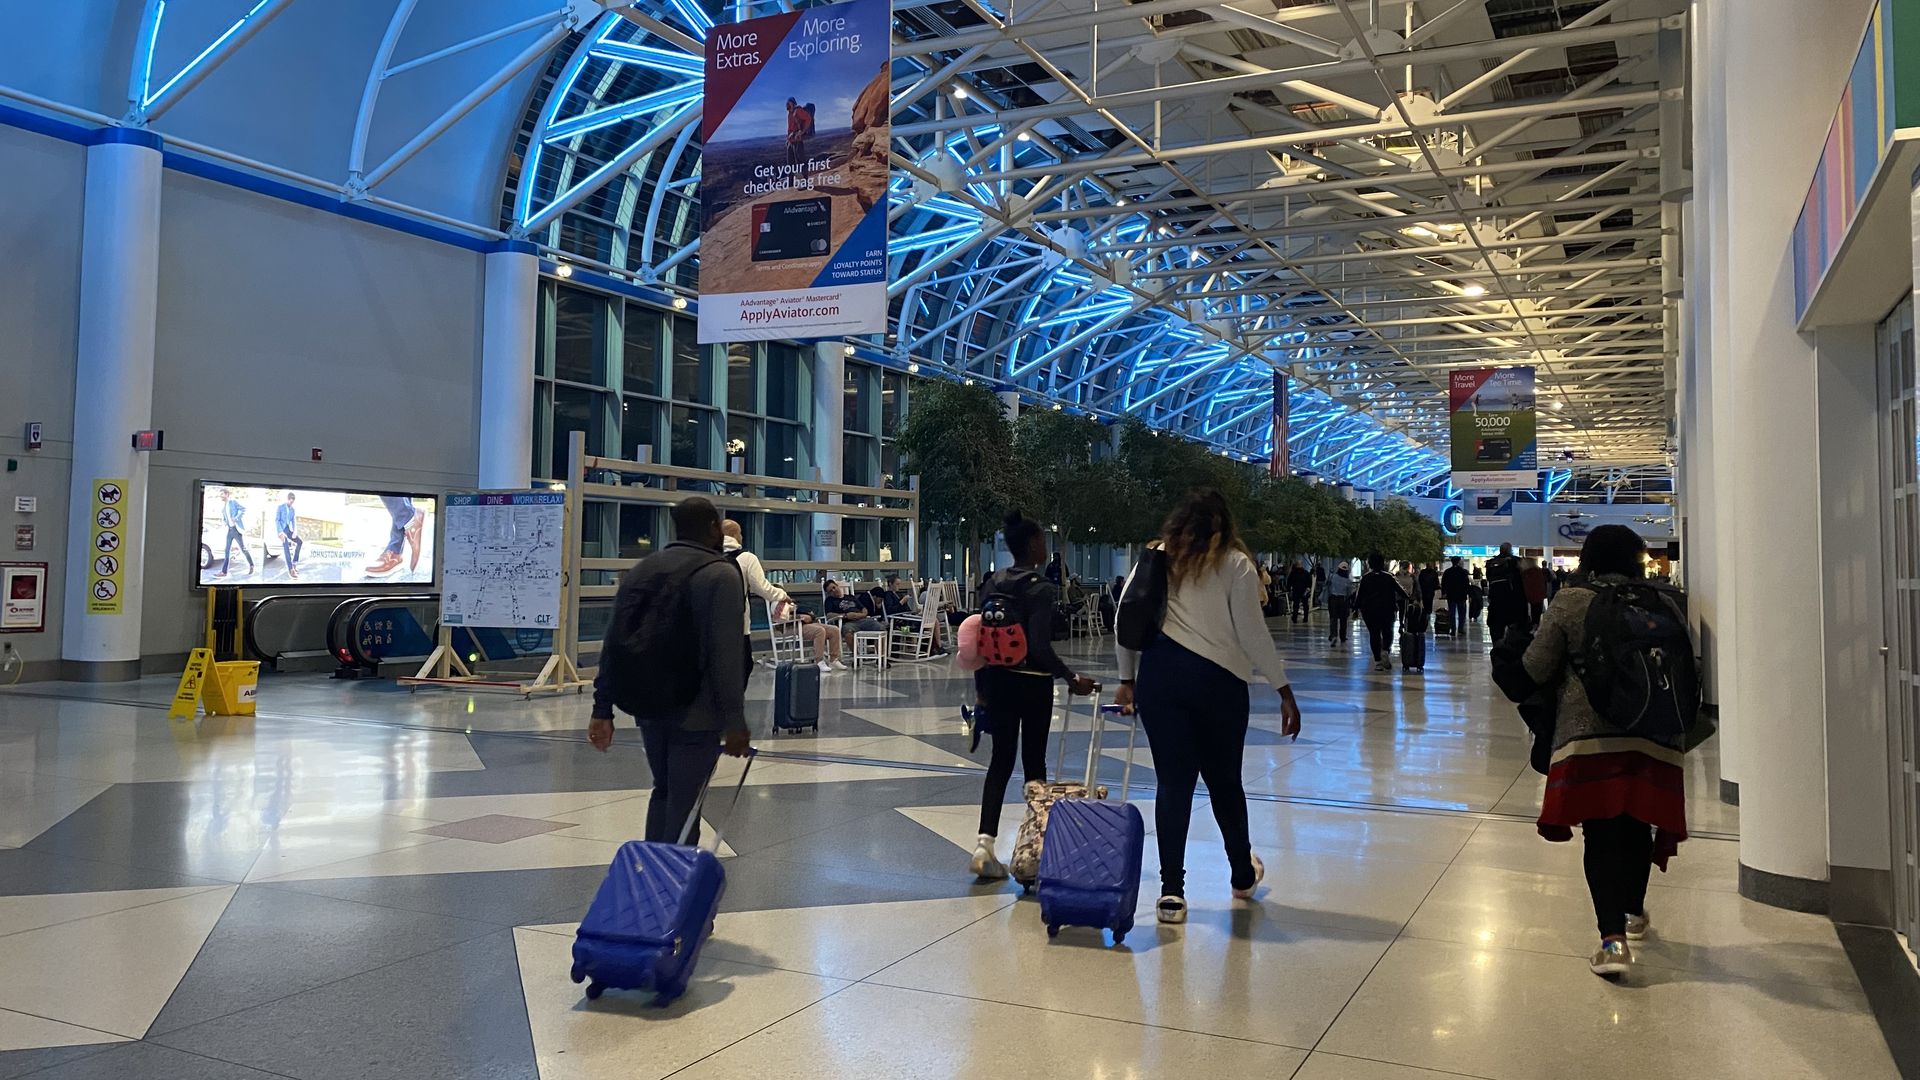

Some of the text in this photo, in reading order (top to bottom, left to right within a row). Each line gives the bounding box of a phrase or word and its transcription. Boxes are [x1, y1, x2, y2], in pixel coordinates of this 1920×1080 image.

[803, 16, 845, 37] More
[716, 31, 758, 51] More
[788, 33, 863, 61] Exploring.
[716, 51, 762, 69] Extras.
[754, 158, 831, 179] Get your first
[743, 172, 841, 194] checked bag free
[866, 250, 883, 258] EARN
[834, 259, 883, 270] LOYALTY POINTS
[832, 271, 859, 280] TOWARD
[740, 306, 839, 323] ApplyAviator.com
[1454, 373, 1475, 382] More
[1494, 372, 1515, 380] More
[1454, 381, 1476, 389] Travel
[1475, 417, 1511, 428] 50,000
[453, 497, 471, 505] SHOP
[487, 496, 504, 505] DINE
[1456, 513, 1464, 526] B
[537, 614, 551, 623] CLT
